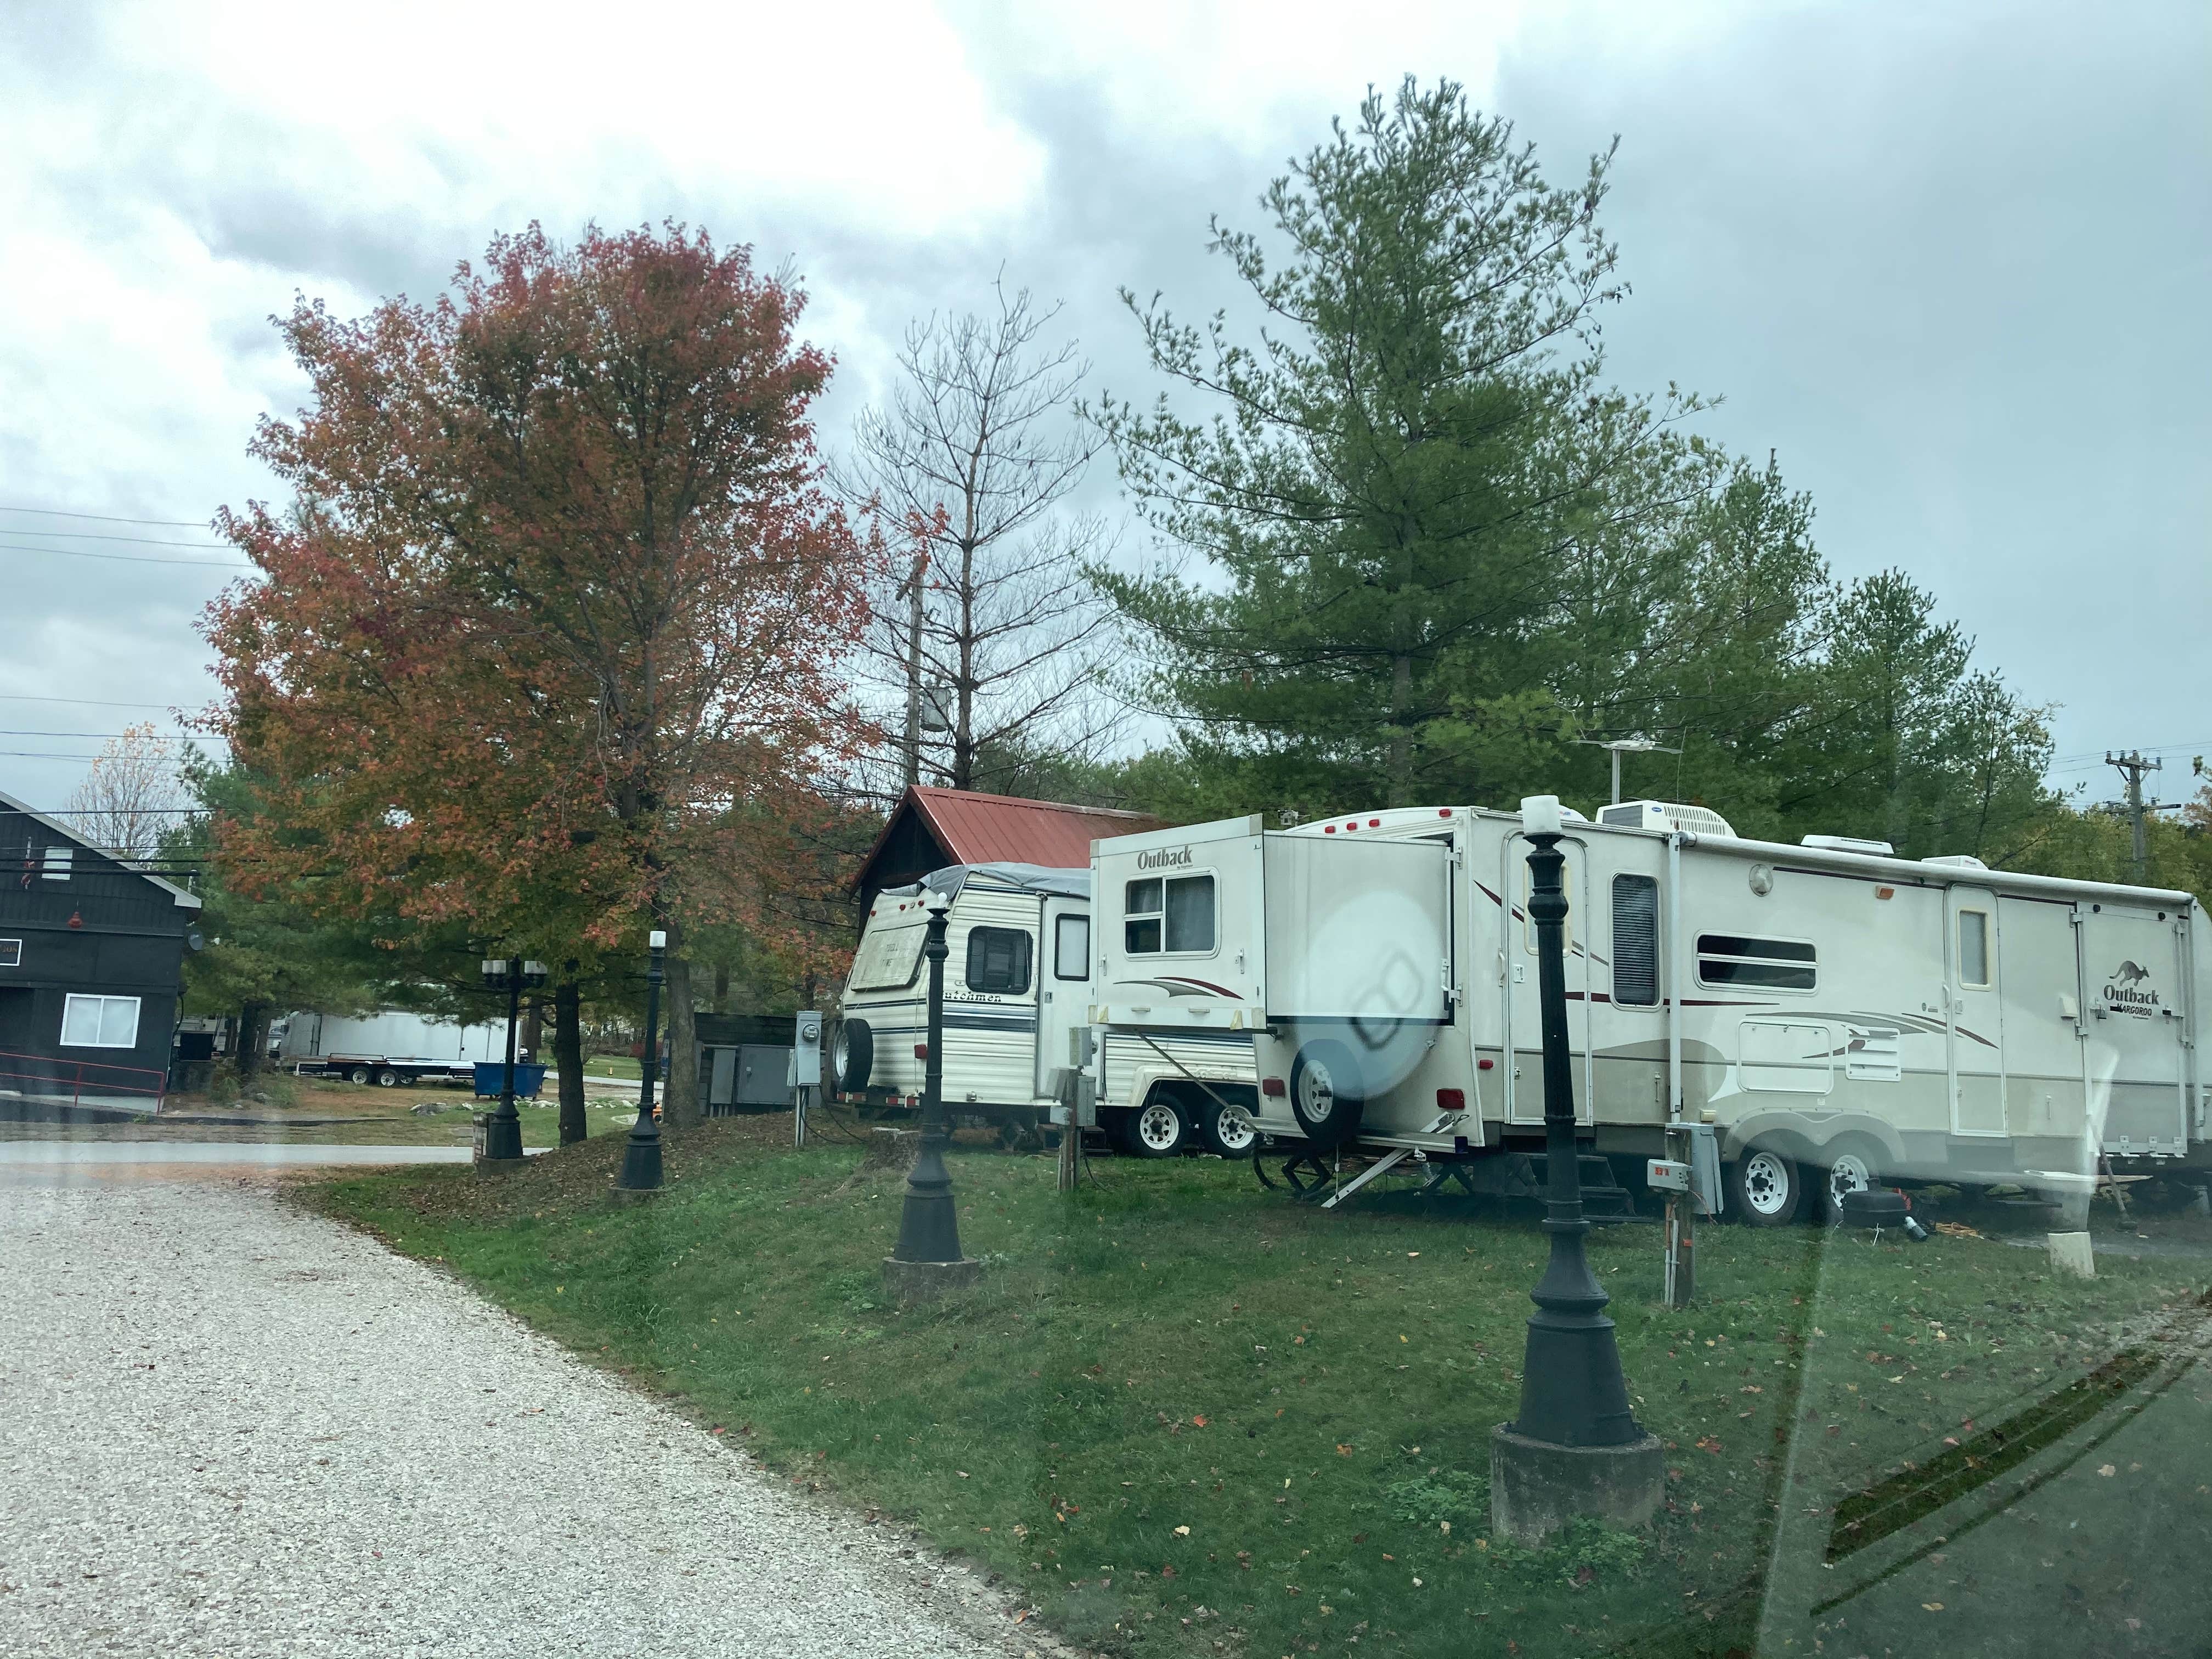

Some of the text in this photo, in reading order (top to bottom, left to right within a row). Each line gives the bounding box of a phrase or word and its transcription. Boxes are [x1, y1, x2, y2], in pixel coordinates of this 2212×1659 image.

[1137, 845, 1193, 870] Outback
[942, 990, 1002, 1002] utchmen
[2103, 985, 2160, 1005] Outback
[2117, 1003, 2152, 1016] KARGOROO
